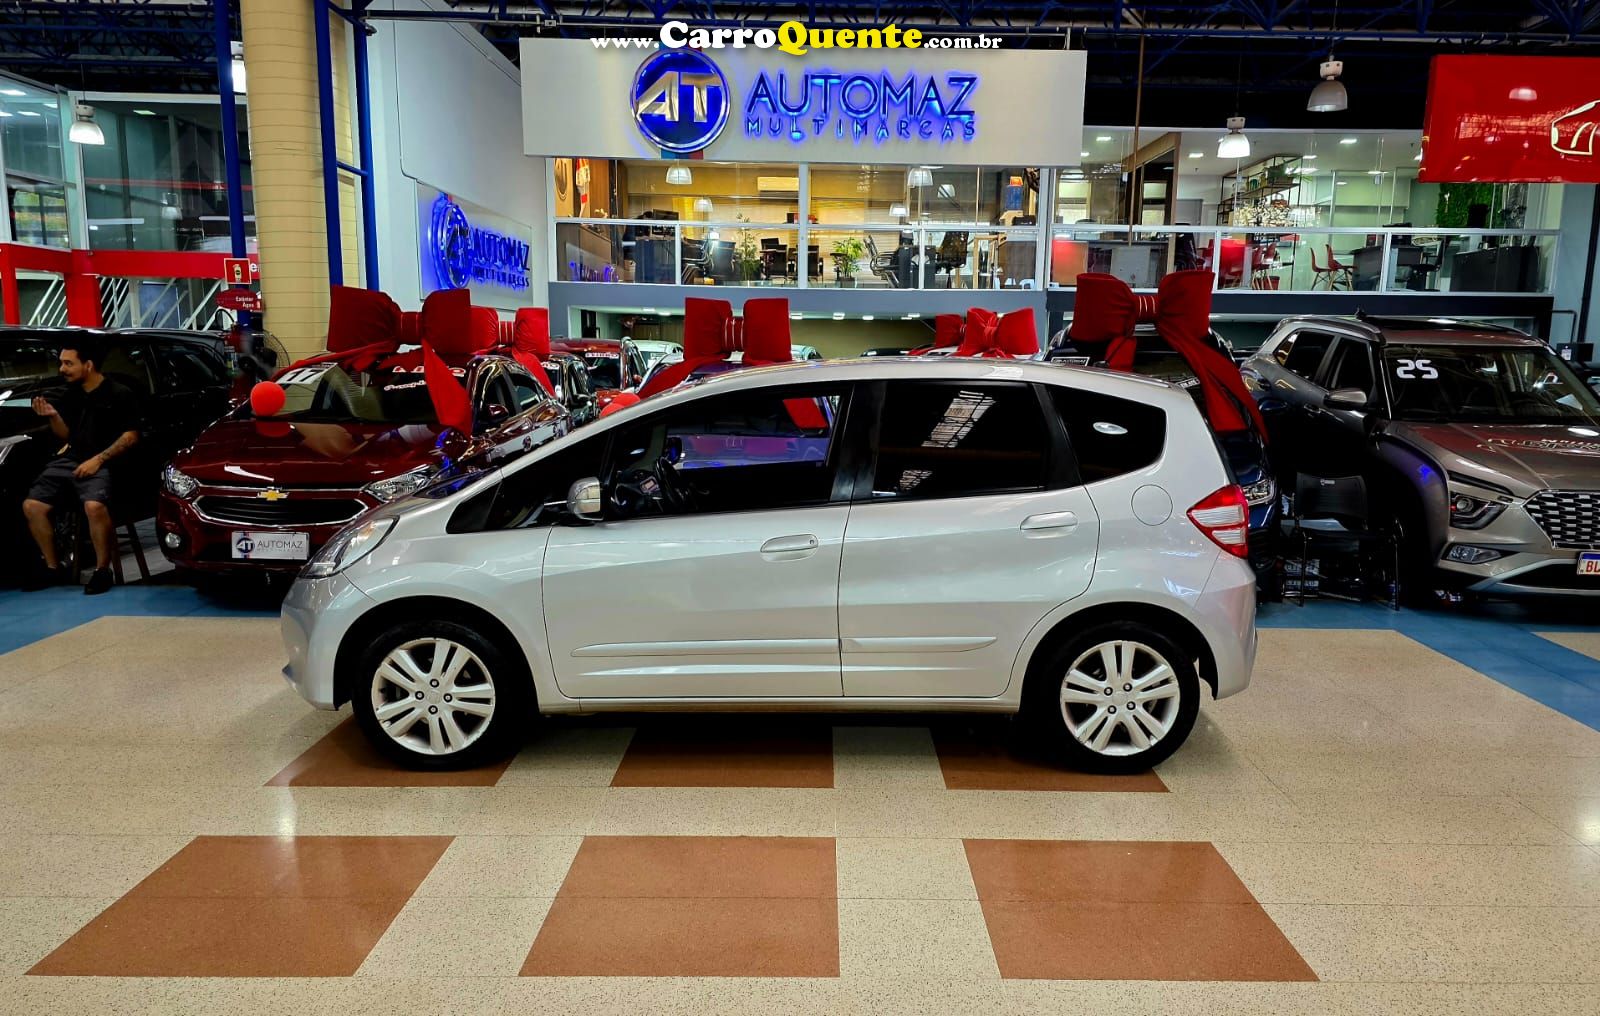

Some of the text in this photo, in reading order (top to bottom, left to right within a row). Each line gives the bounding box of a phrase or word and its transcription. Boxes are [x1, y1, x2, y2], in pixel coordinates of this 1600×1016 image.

[746, 73, 978, 116] AUTOMAZ
[746, 118, 976, 138] MULTIMARCAS
[286, 368, 325, 382] 17
[1396, 359, 1439, 379] 25
[257, 540, 303, 549] AUTOMAZ
